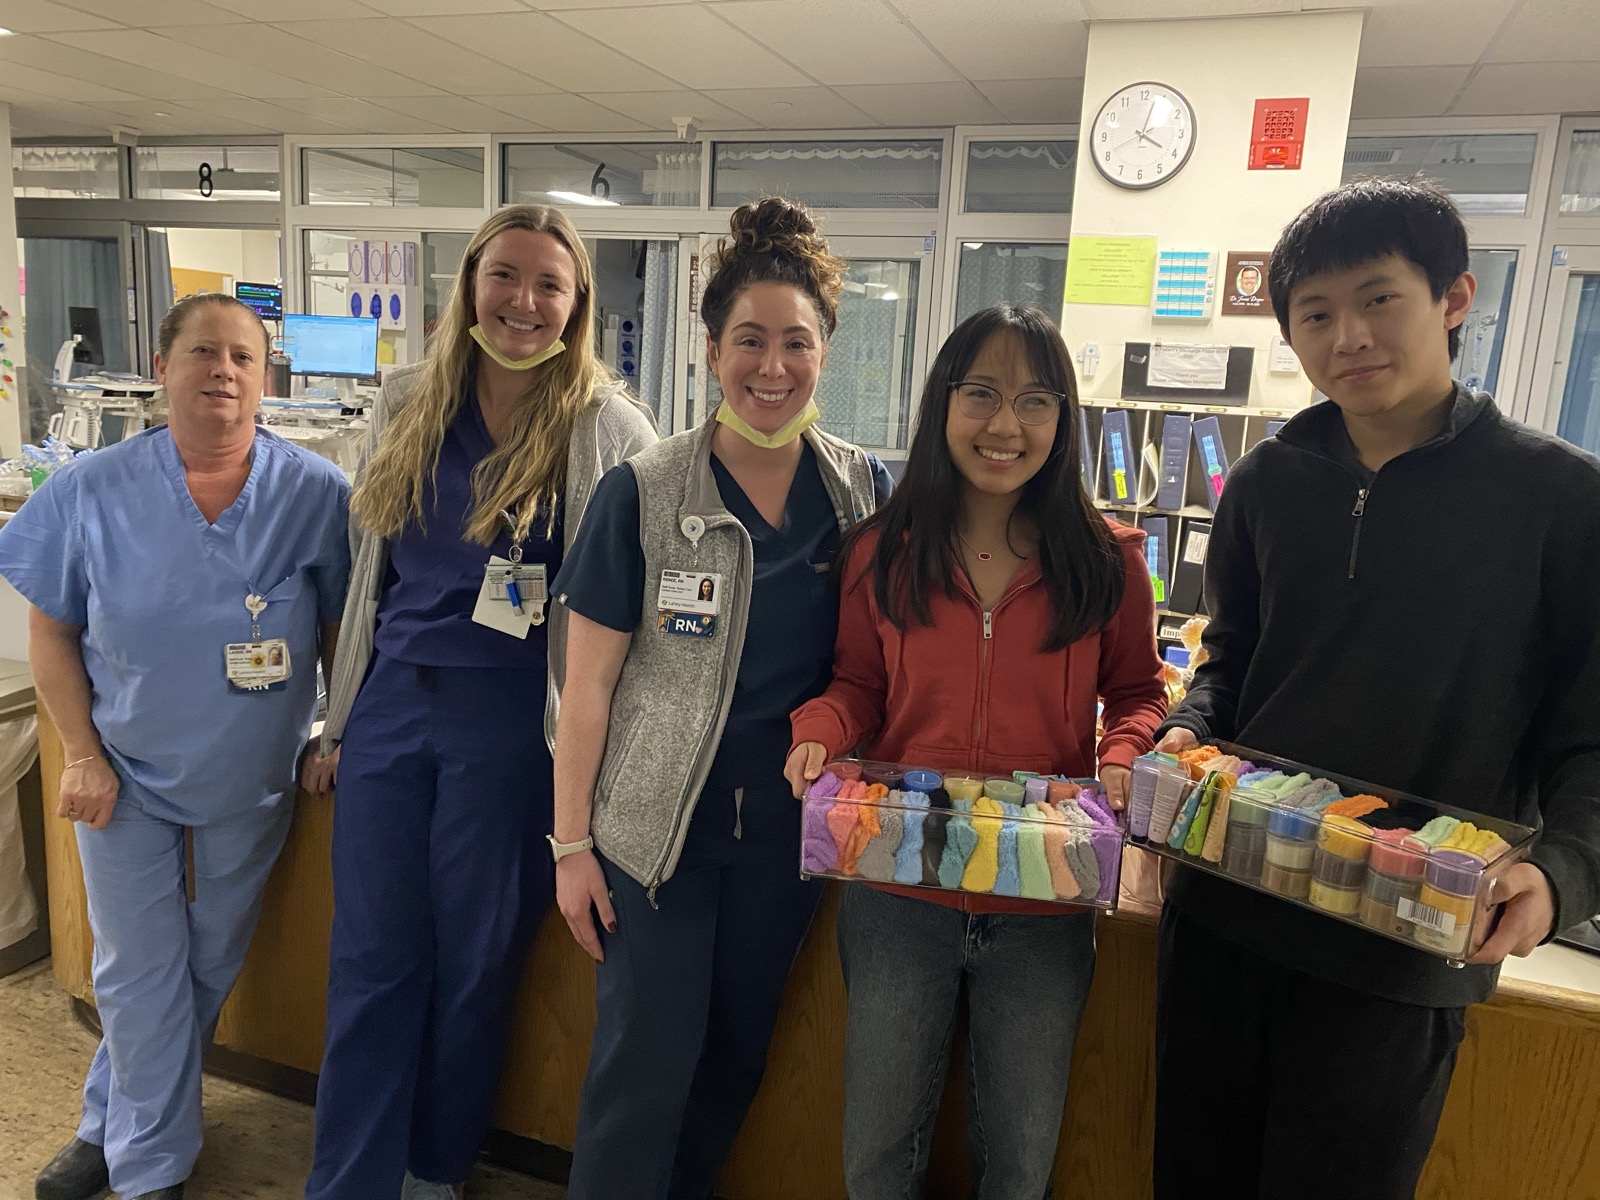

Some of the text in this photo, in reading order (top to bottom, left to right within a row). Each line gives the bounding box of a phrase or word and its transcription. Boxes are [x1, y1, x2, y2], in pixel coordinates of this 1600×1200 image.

[1140, 90, 1150, 101] 12
[1121, 97, 1130, 108] 11
[1174, 109, 1181, 120] 2
[1101, 132, 1108, 143] 9
[1178, 129, 1185, 139] 3
[1105, 151, 1111, 161] 8
[1171, 148, 1178, 159] 4
[1118, 165, 1124, 175] 7
[1156, 163, 1163, 174] 5
[199, 162, 213, 197] 8
[1137, 169, 1143, 180] 6
[591, 162, 609, 201] 6
[675, 618, 697, 633] RN
